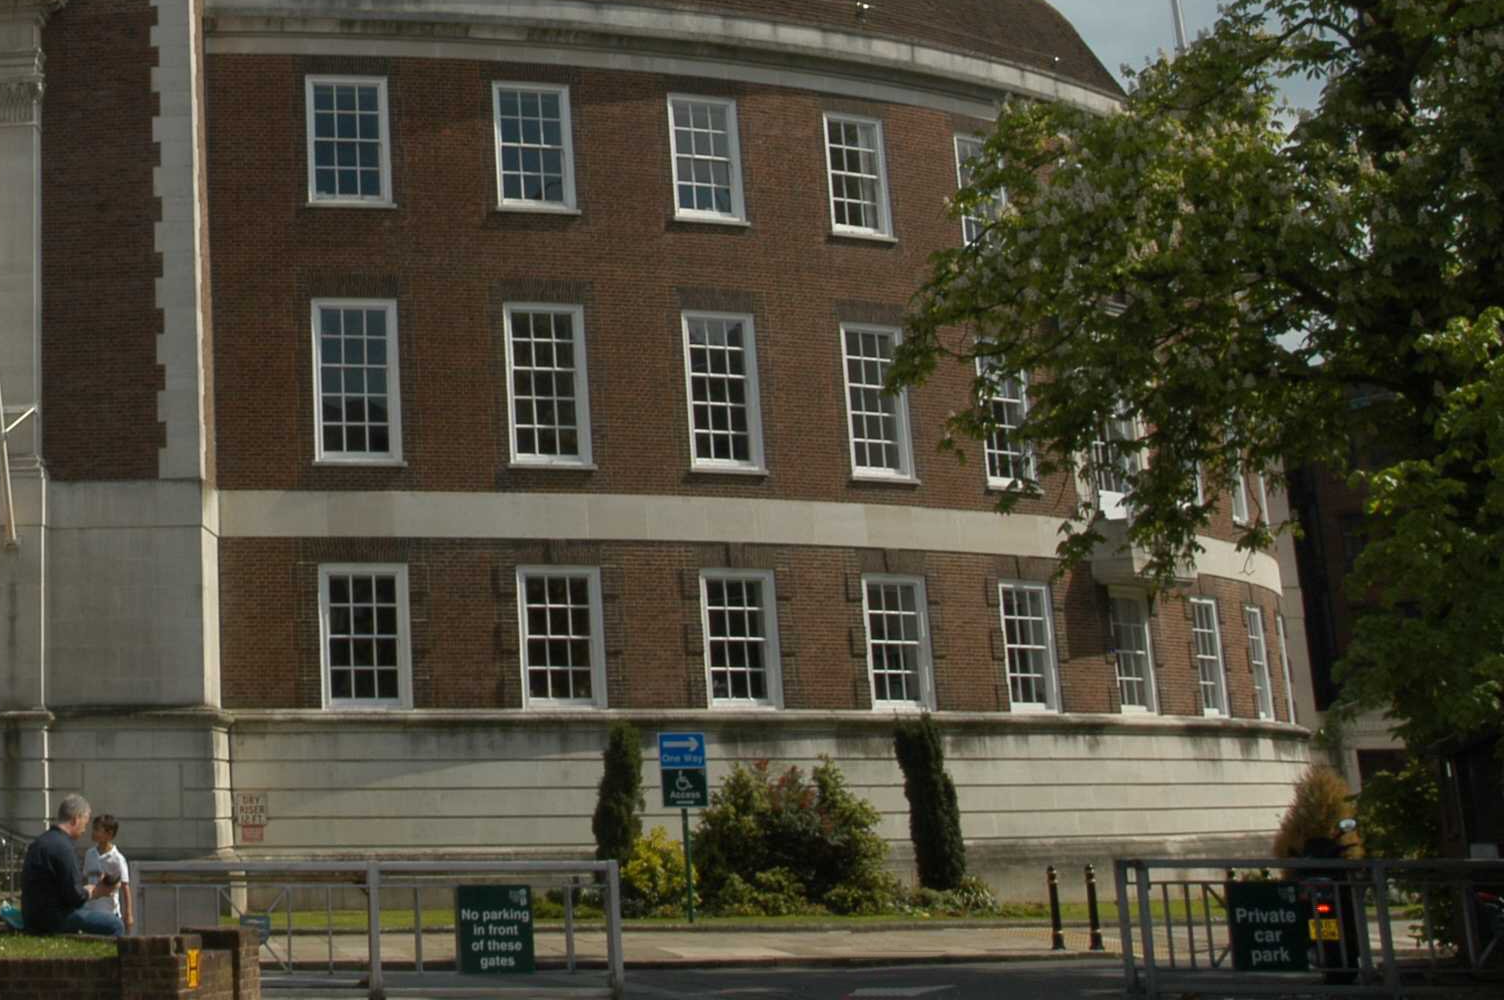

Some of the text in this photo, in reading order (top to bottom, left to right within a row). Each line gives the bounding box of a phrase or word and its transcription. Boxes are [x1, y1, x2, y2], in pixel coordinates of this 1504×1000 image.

[662, 753, 704, 764] One Way
[670, 790, 701, 799] Access
[239, 806, 265, 814] RISER
[461, 908, 530, 923] No parking
[1235, 907, 1297, 924] Private
[473, 924, 519, 936] in front
[1254, 930, 1283, 944] car
[472, 939, 523, 952] of these
[1251, 946, 1291, 965] park
[480, 956, 516, 970] gates
